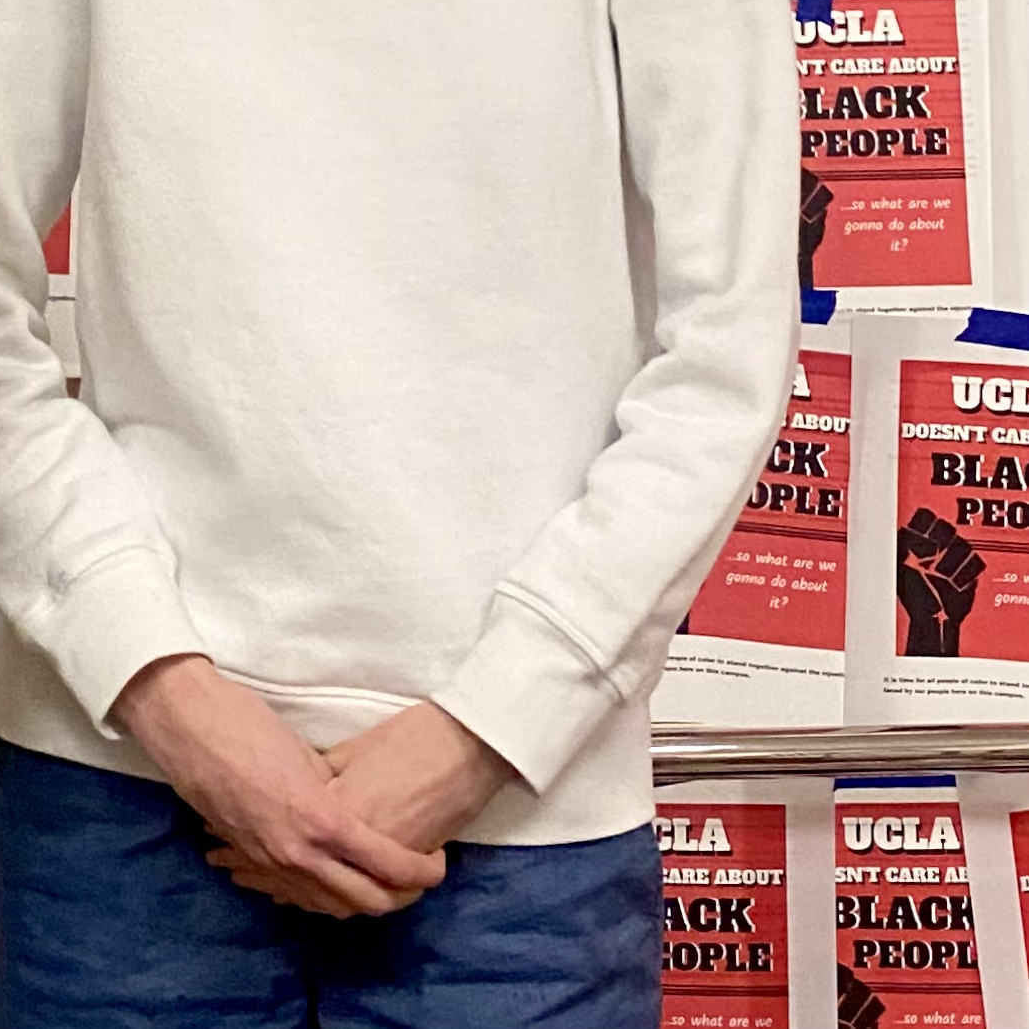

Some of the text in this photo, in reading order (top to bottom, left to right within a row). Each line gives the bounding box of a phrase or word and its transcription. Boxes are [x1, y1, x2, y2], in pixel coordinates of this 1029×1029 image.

[830, 57, 883, 75] CARE
[889, 56, 956, 75] ABOUT
[800, 85, 931, 119] LACK
[801, 127, 949, 157] PEOPLE
[871, 196, 901, 209] what
[909, 198, 928, 209] are
[934, 198, 950, 209] we
[844, 218, 944, 235] gonna do about
[891, 239, 908, 252] it?
[902, 423, 987, 443] DOESN'T
[756, 552, 789, 567] what
[793, 557, 815, 569] are
[819, 560, 837, 572] we
[726, 572, 827, 592] gonna do about
[770, 596, 789, 609] it?
[842, 817, 961, 855] UCLA
[714, 868, 783, 885] ABOUT
[885, 867, 940, 884] CARE
